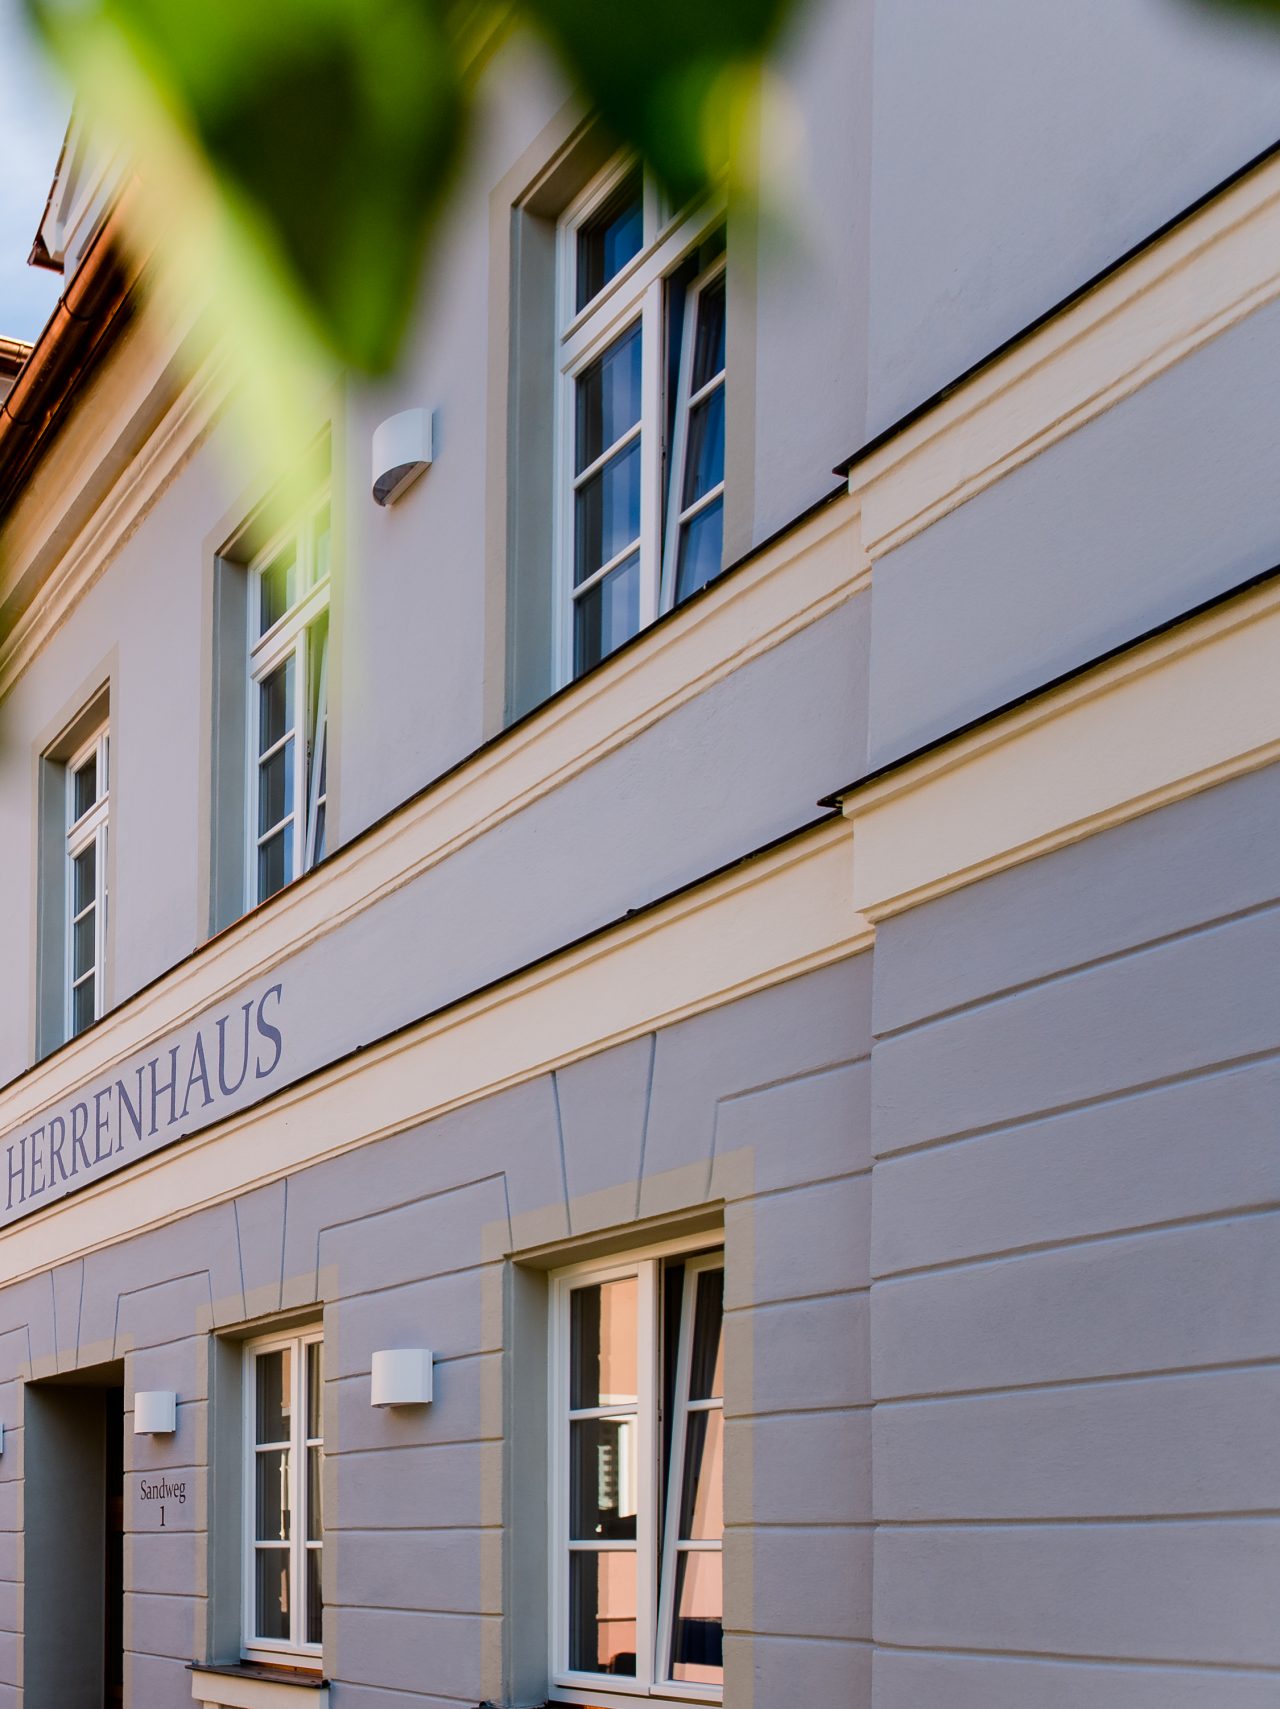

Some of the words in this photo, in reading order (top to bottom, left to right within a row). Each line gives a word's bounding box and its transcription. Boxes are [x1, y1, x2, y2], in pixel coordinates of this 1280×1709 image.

[5, 983, 283, 1211] HERRENHAUS
[140, 1477, 186, 1504] Sandweg
[159, 1505, 166, 1527] 1
